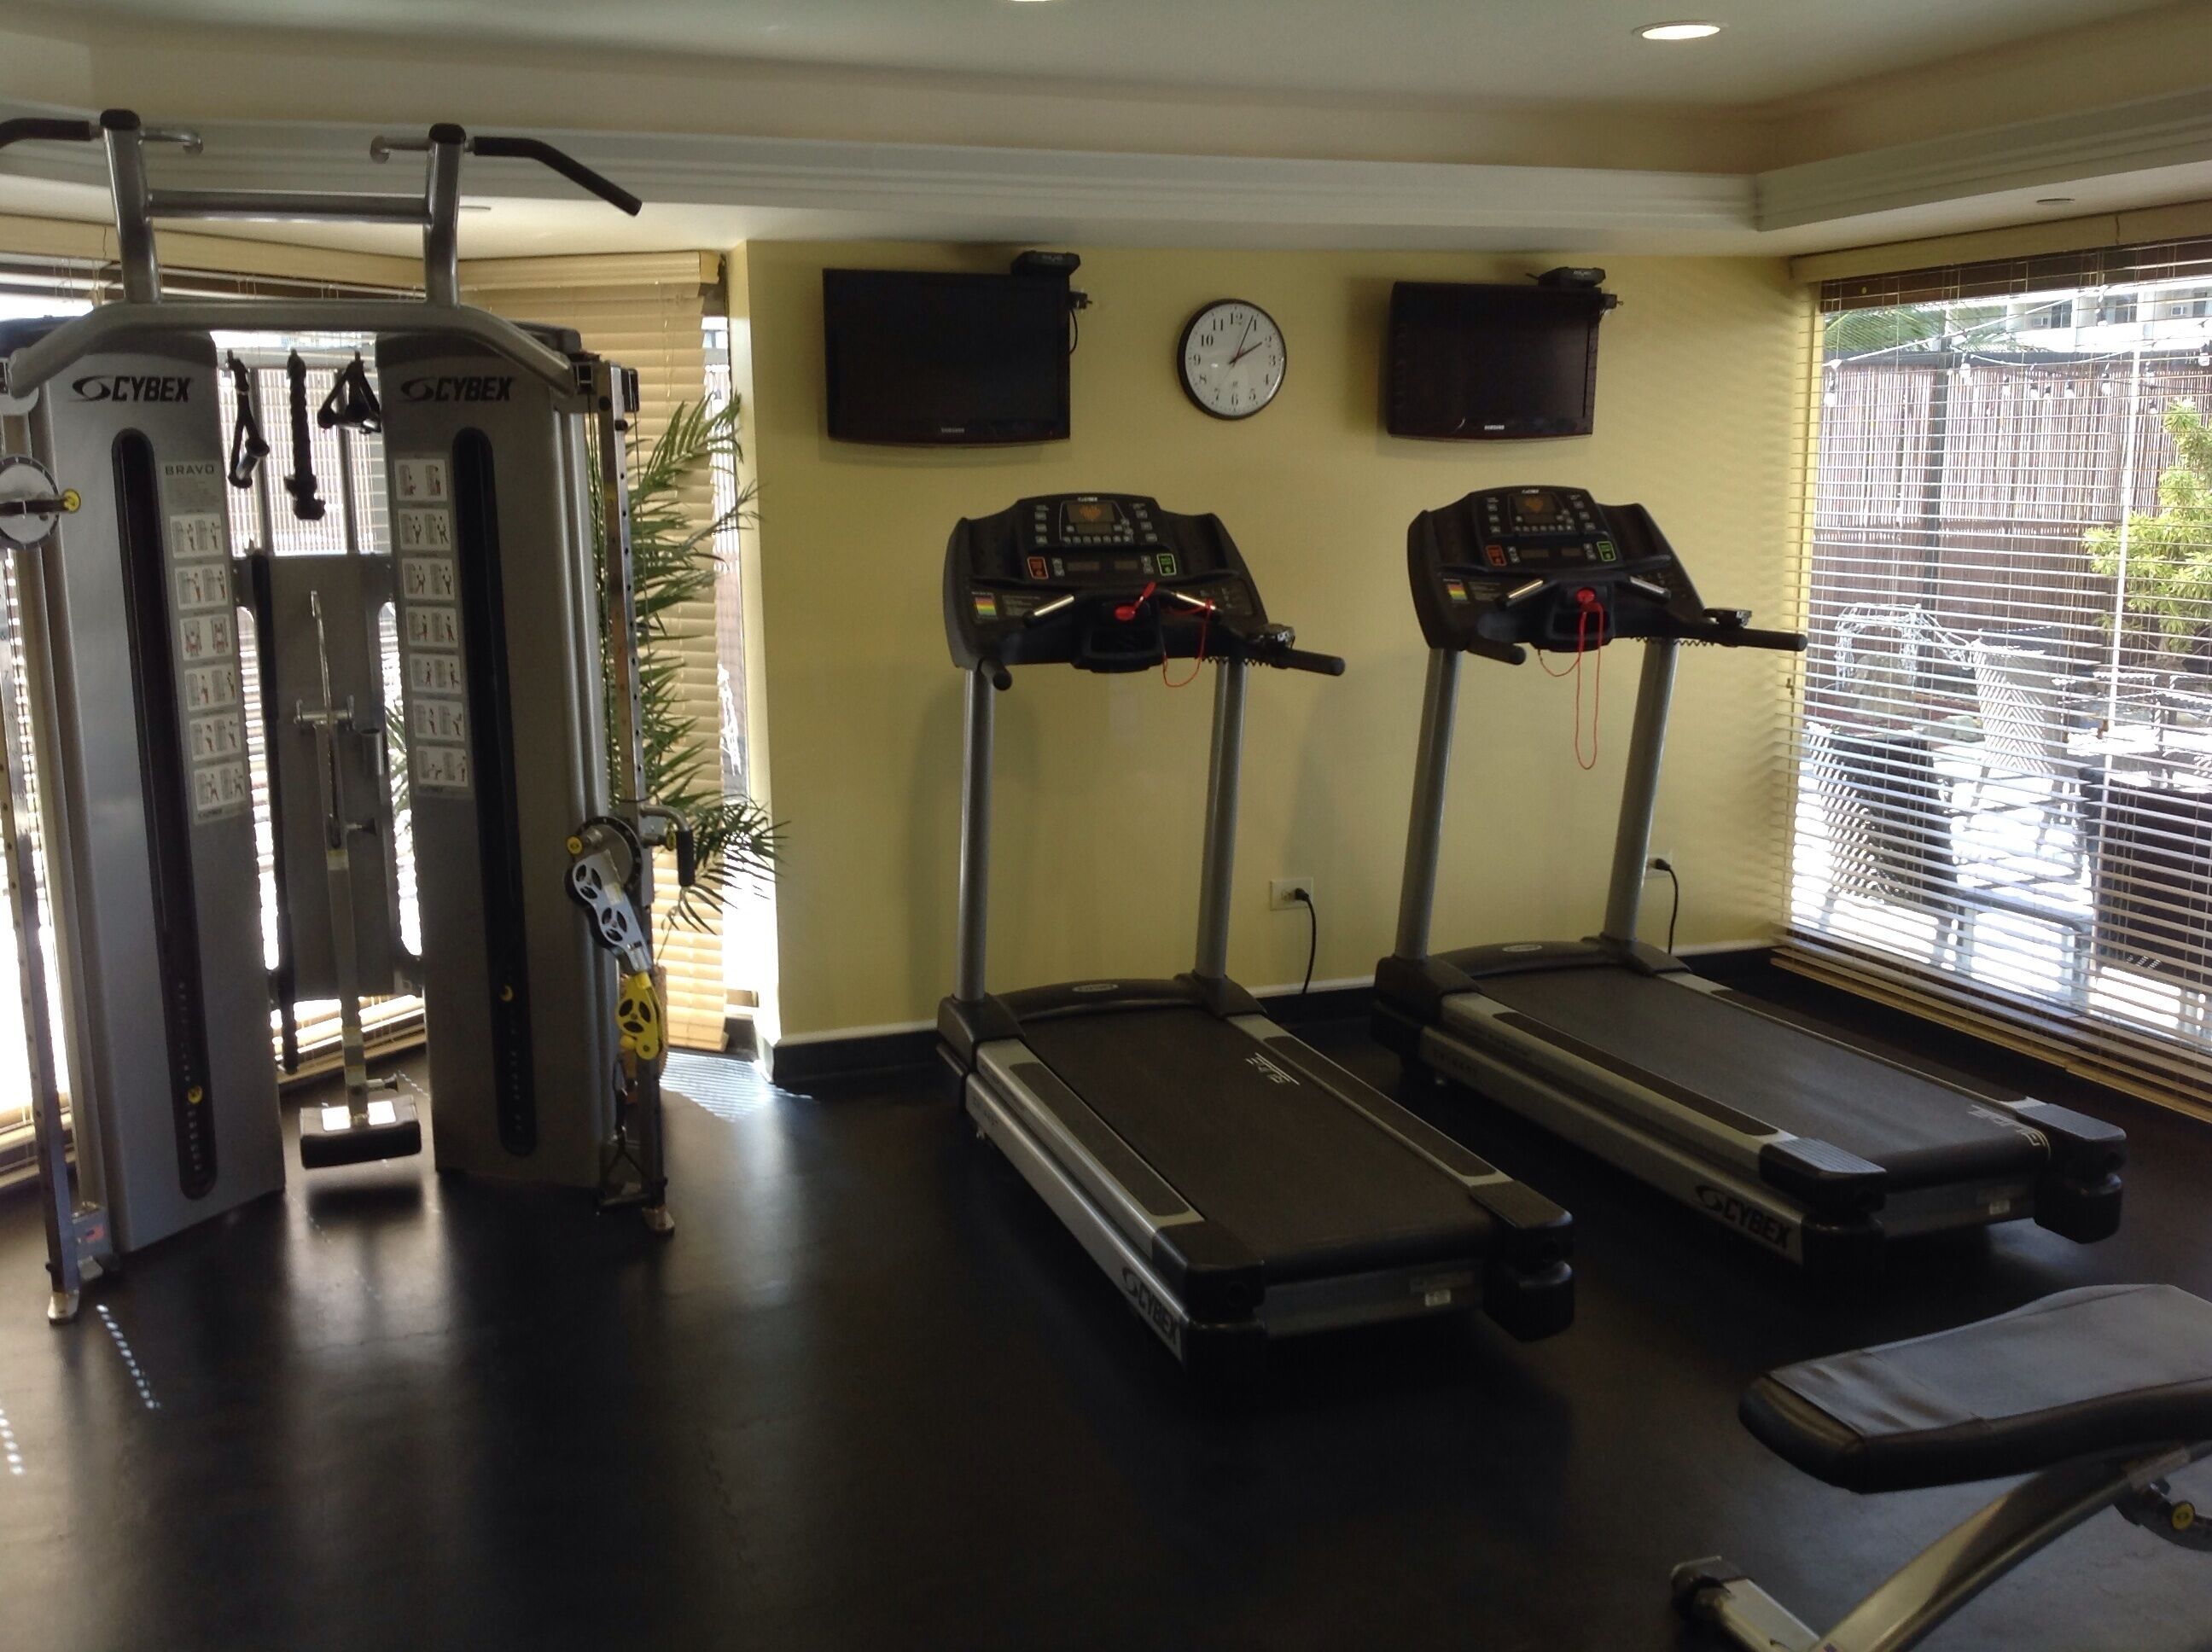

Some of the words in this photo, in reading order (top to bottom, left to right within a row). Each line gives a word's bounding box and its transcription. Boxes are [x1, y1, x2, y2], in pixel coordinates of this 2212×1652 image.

[1213, 318, 1224, 331] 11
[1201, 334, 1214, 346] 10
[1265, 335, 1272, 347] 2
[1194, 354, 1201, 365] 9
[1270, 355, 1276, 366] 3
[112, 375, 191, 402] CYBEX
[434, 376, 513, 402] CYBEX
[1214, 387, 1220, 400] 7
[1249, 388, 1256, 401] 5
[1231, 393, 1238, 405] 6
[165, 464, 214, 475] BRAVO
[1724, 1195, 1791, 1249] CYBEX
[1138, 1281, 1178, 1346] CYBEX
